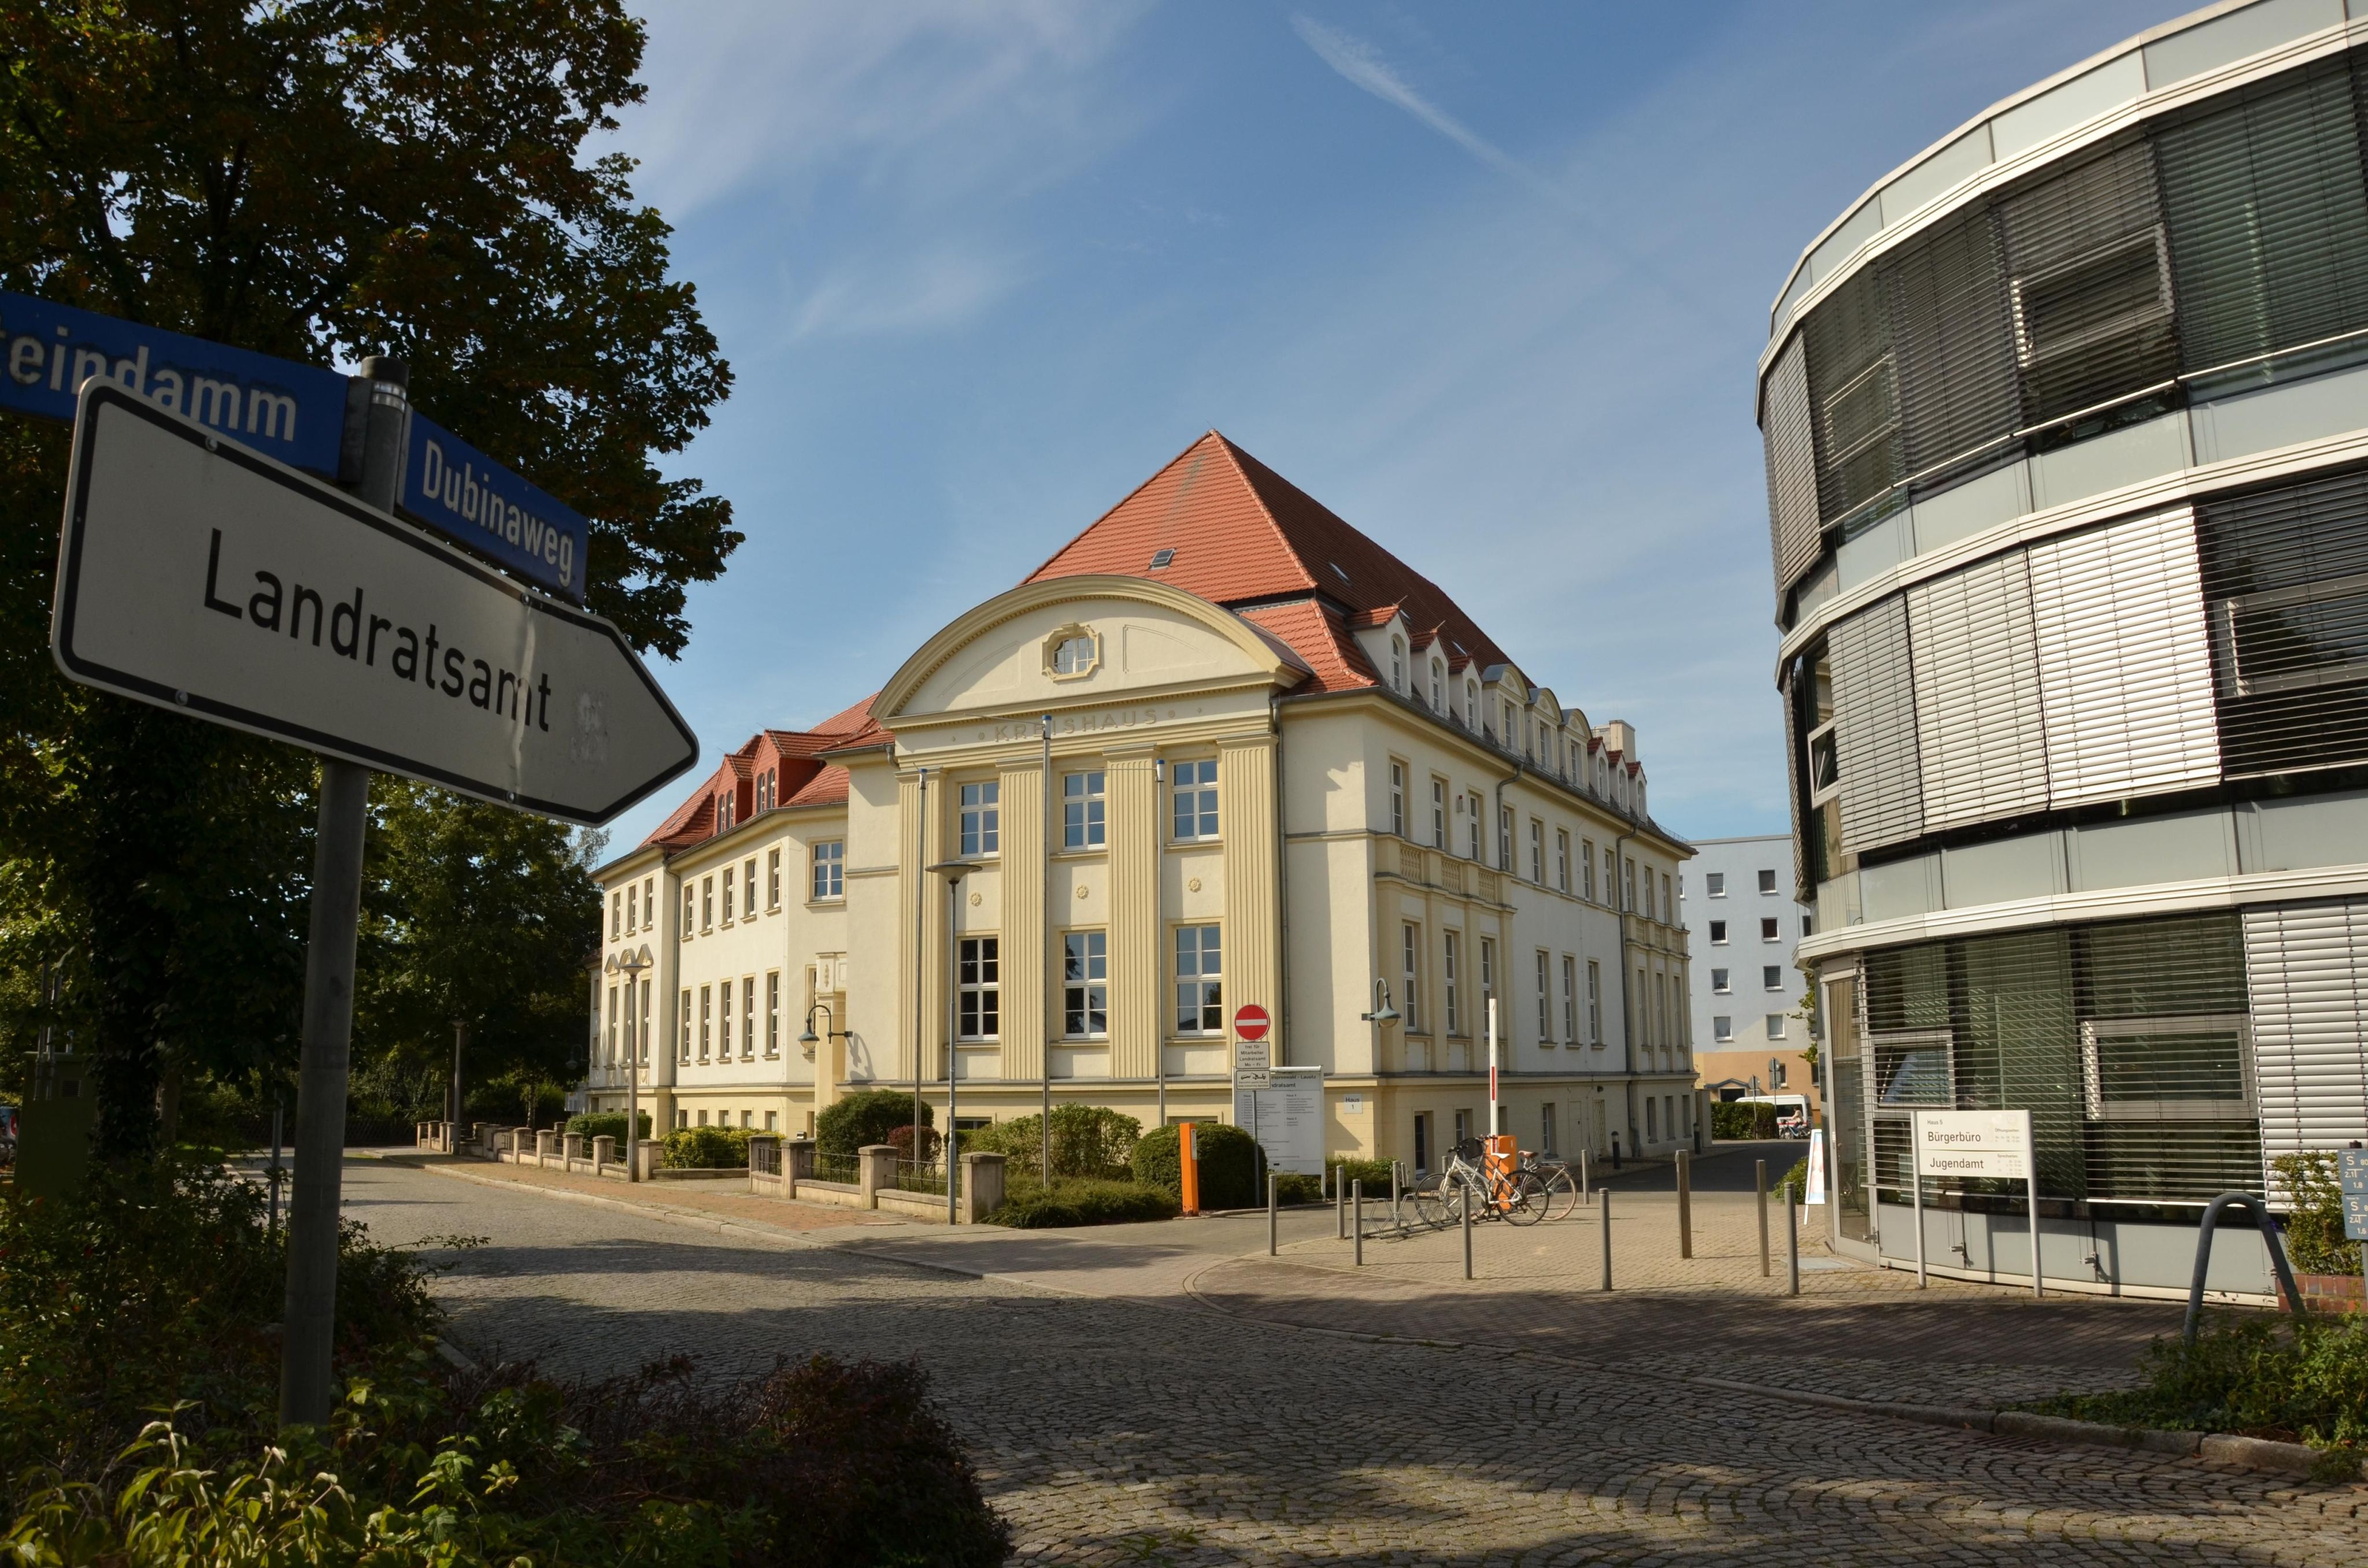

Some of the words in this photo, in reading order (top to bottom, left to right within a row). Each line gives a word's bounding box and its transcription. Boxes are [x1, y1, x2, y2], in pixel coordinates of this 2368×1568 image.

[0, 316, 297, 442] eindamm
[423, 439, 573, 587] Dubinaweg
[204, 527, 551, 732] Landratsamt
[994, 708, 1157, 743] KREISHAUS
[1928, 1131, 1981, 1144] Bürgerbüro
[1930, 1157, 1984, 1170] Jugendamt
[2346, 1156, 2354, 1165] S
[2351, 1202, 2358, 1211] S
